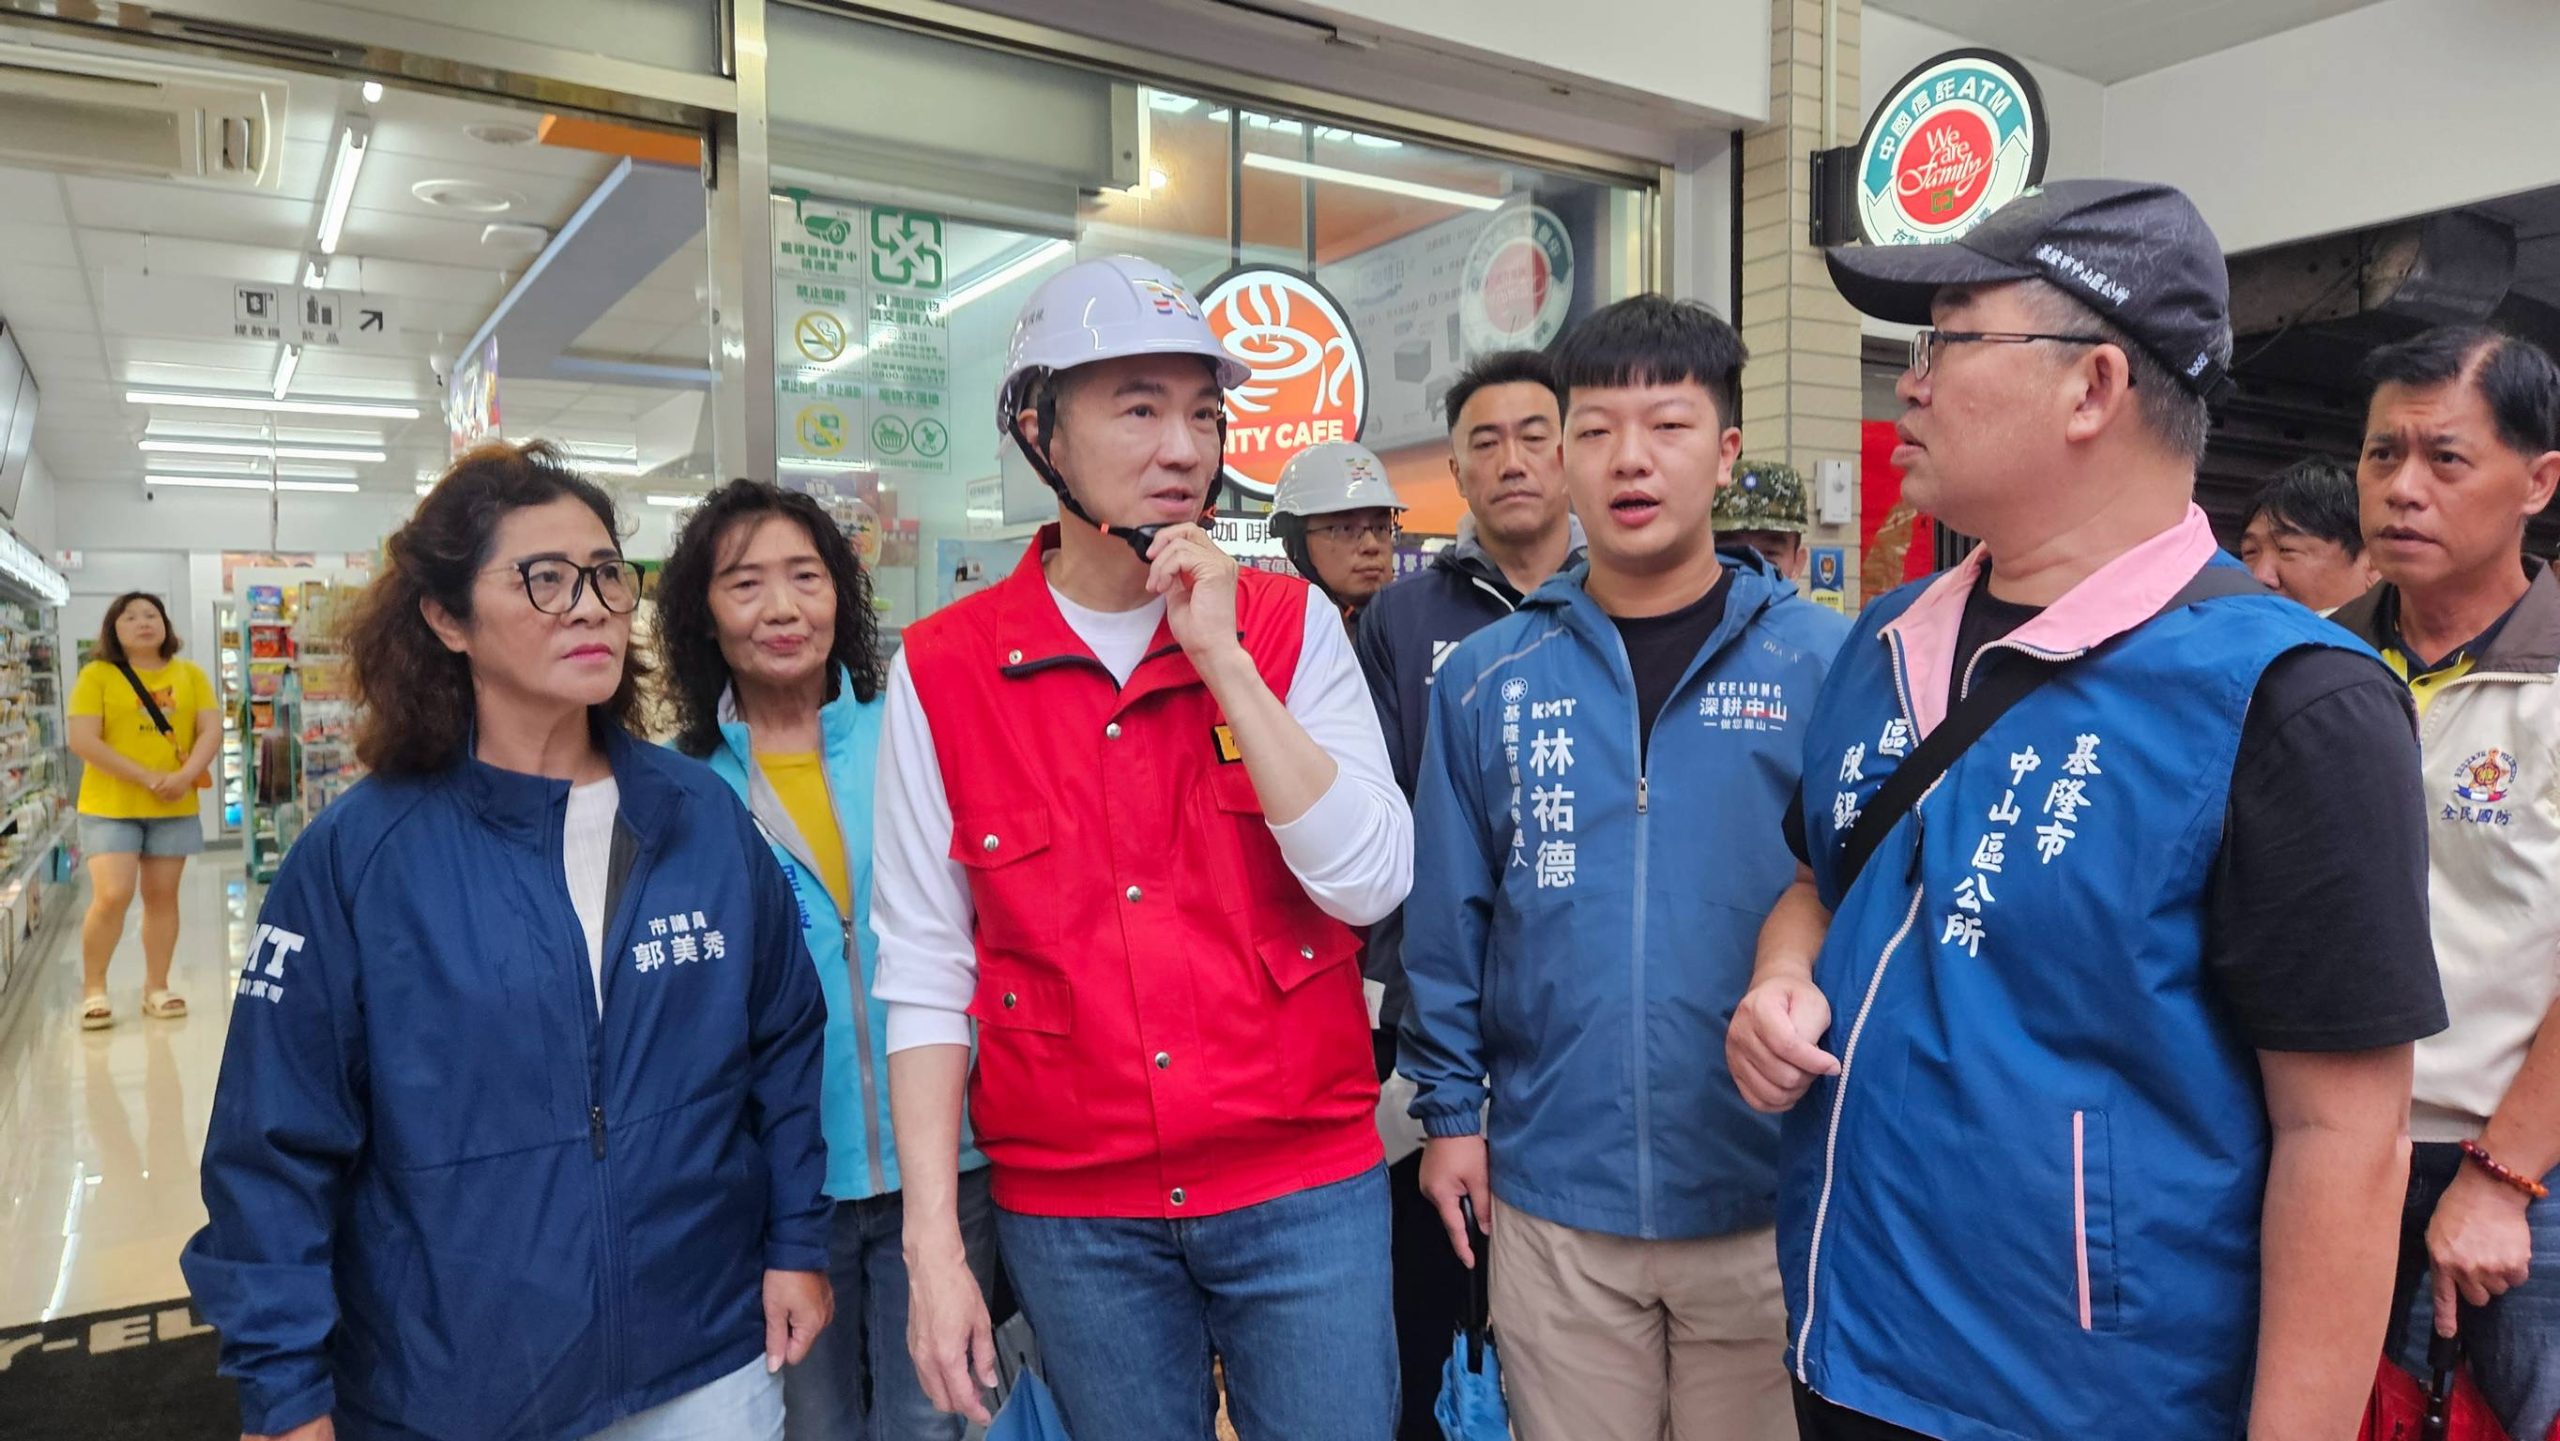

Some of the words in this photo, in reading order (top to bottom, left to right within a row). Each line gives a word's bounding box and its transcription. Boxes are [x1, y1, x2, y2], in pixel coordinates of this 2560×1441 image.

[1926, 124, 1960, 155] We
[1940, 141, 1970, 165] are
[1897, 147, 1994, 198] Family
[1275, 419, 1344, 447] CAFE
[1707, 682, 1782, 699] KEELUNG
[1531, 698, 1577, 719] KMT
[1700, 696, 1788, 722] 深耕中山
[1878, 718, 1911, 757] 區
[1832, 741, 1866, 830] 陳錫
[2036, 733, 2103, 864] 基隆市
[1529, 727, 1577, 889] 林祐德
[2440, 803, 2513, 826] 全民國防
[1941, 744, 2042, 958] 中山區公所
[632, 930, 726, 973] 郭美秀
